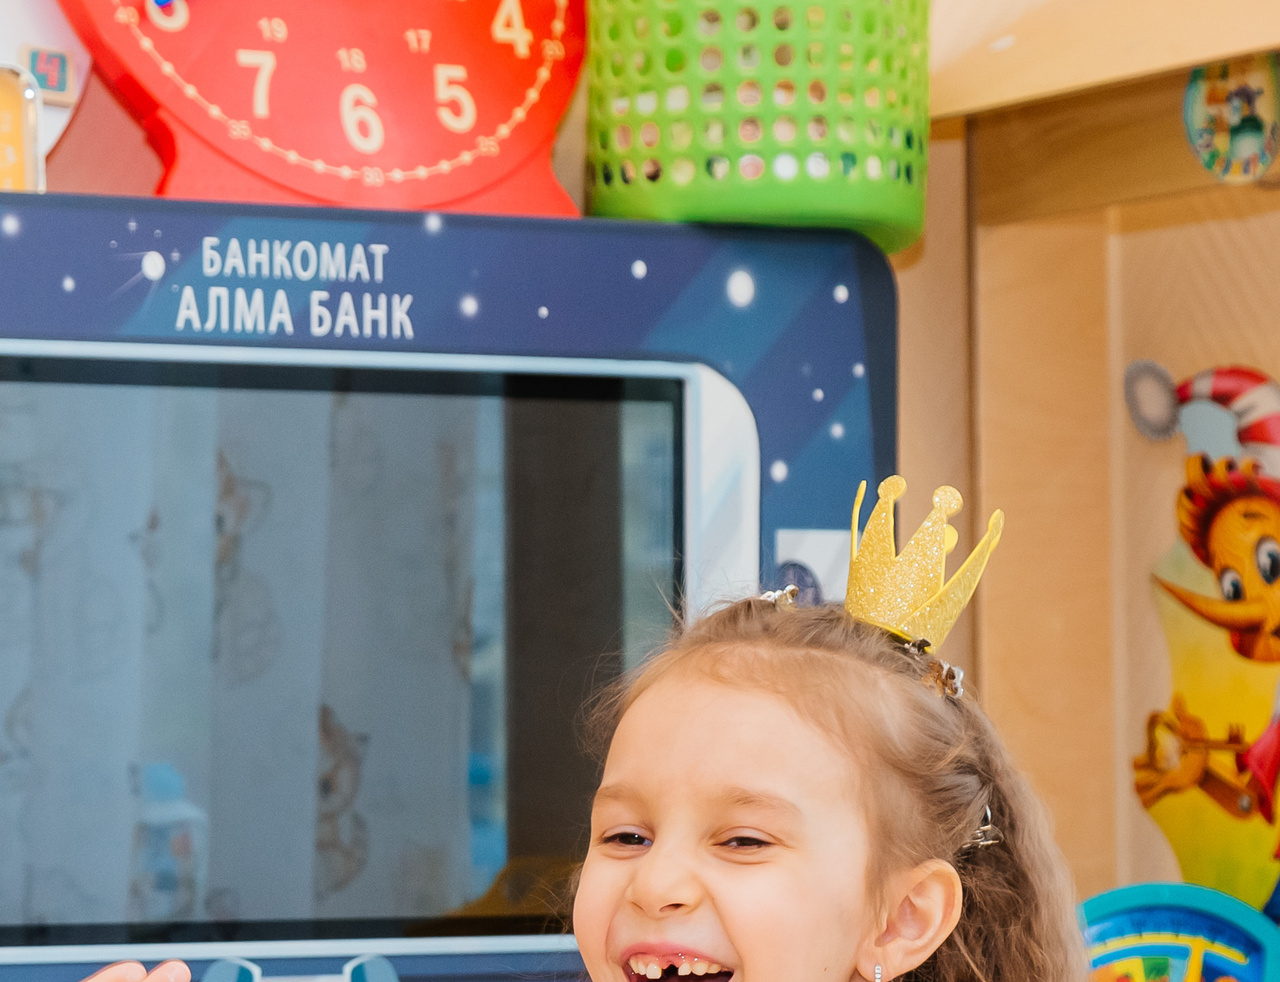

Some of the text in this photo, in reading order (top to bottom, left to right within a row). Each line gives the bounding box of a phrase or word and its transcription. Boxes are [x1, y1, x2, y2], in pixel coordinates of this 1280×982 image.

[257, 16, 289, 43] 19
[403, 28, 433, 54] 17
[491, 0, 534, 58] 4
[235, 48, 277, 119] 7
[335, 47, 367, 74] 18
[339, 82, 385, 155] 6
[432, 62, 477, 134] 5
[202, 236, 390, 284] БАНКОМАТ
[175, 285, 414, 340] АЛМА БАНК
